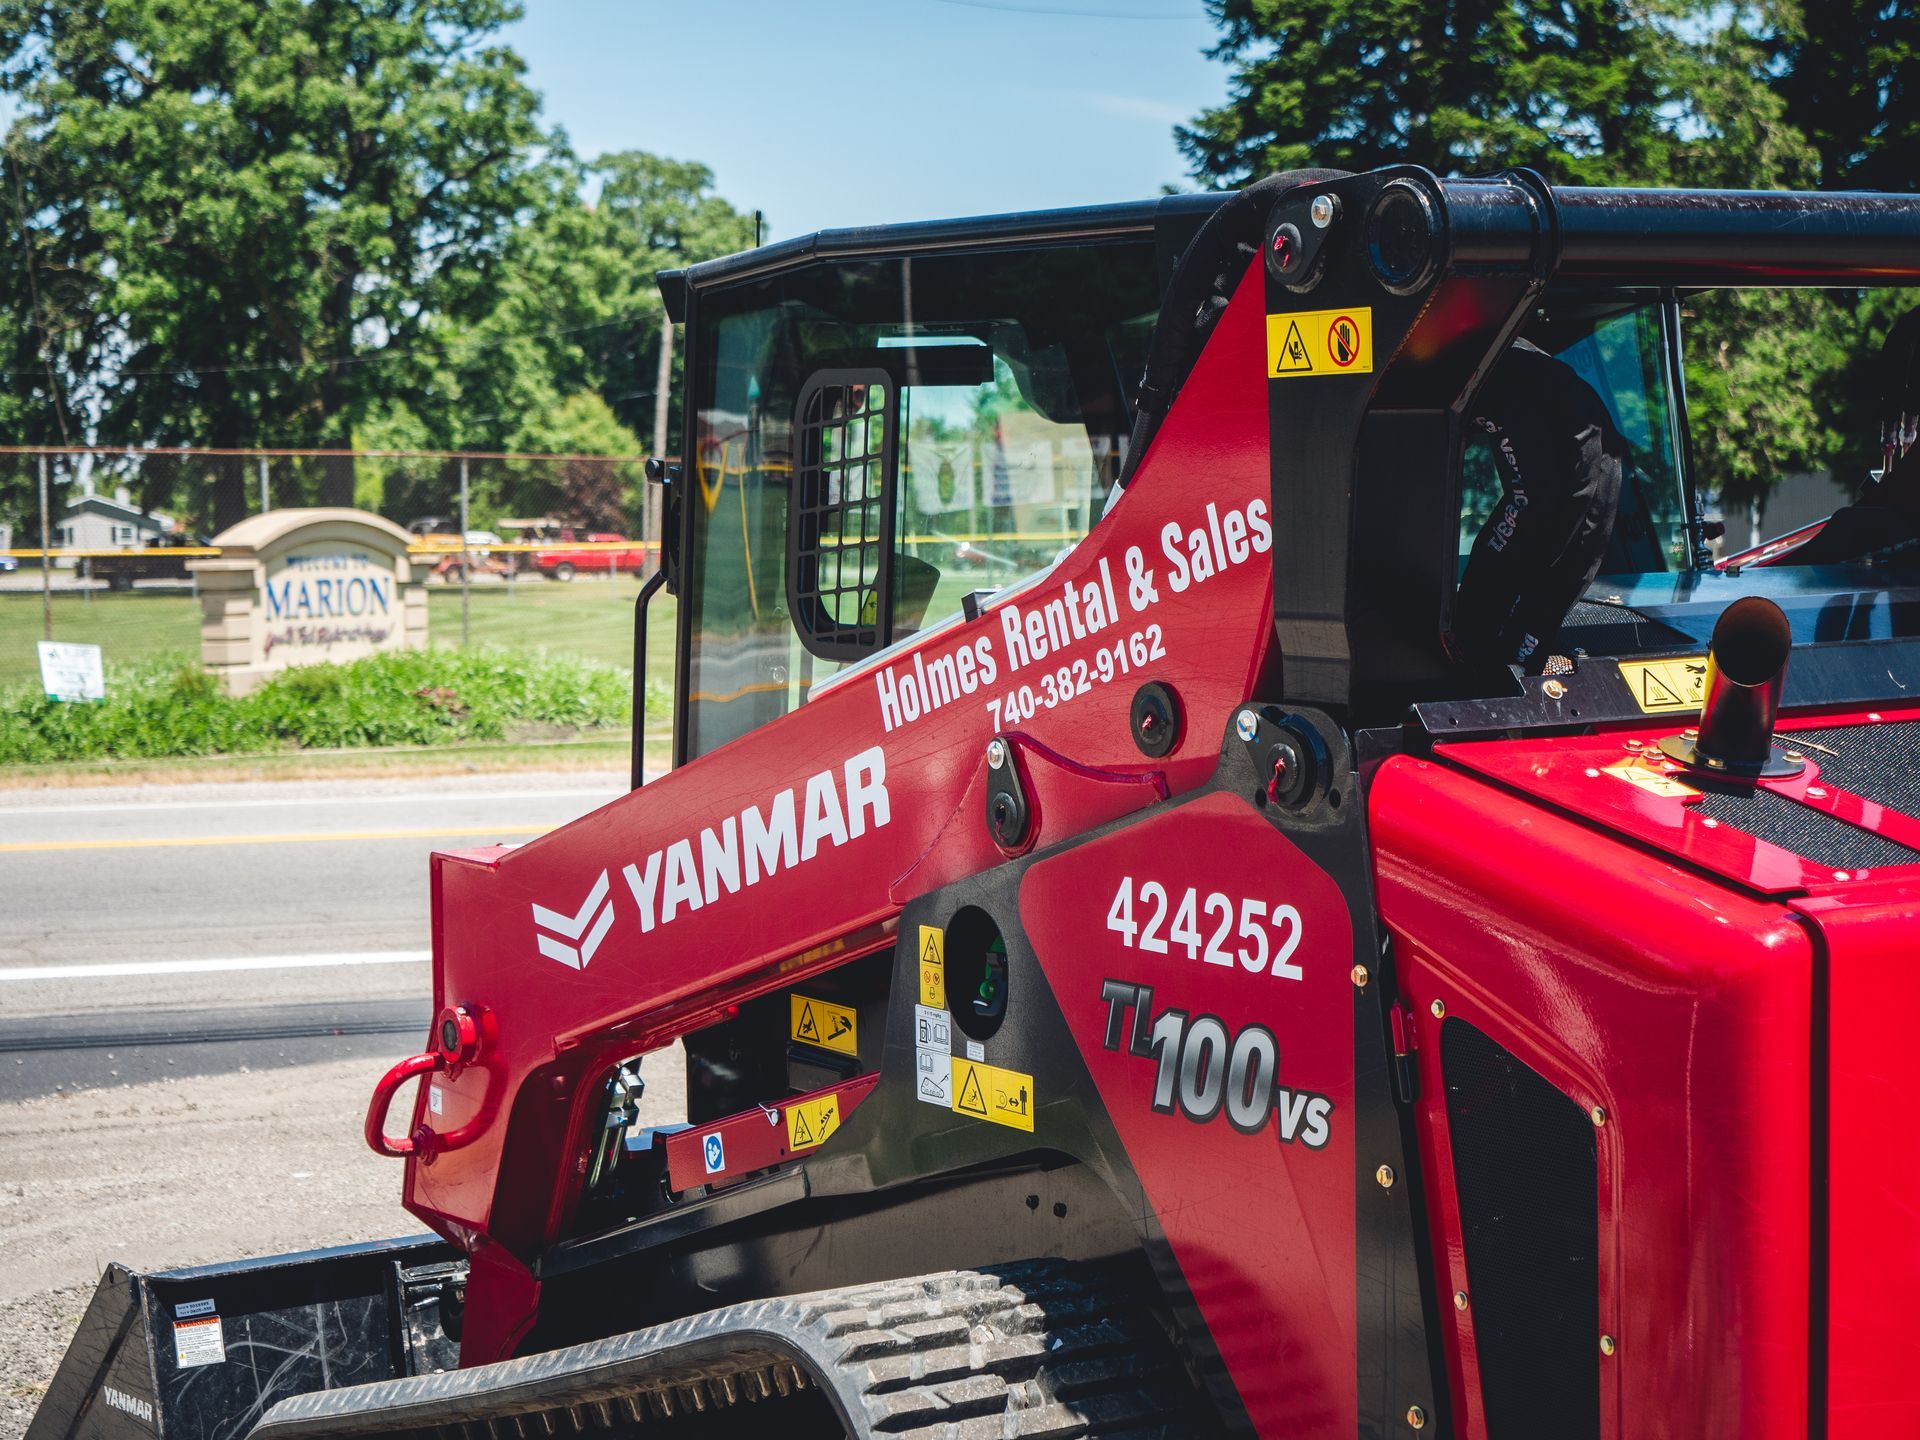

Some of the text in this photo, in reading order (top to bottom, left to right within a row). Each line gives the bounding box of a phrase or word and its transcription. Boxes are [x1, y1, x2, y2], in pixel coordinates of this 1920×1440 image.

[265, 577, 389, 621] MARION
[876, 498, 1272, 733] Holmes Rental & Sales
[987, 624, 1166, 733] 740-382-9162
[622, 746, 890, 933] YANMAR
[1107, 876, 1303, 981] 424252
[104, 1386, 152, 1422] YANMAR
